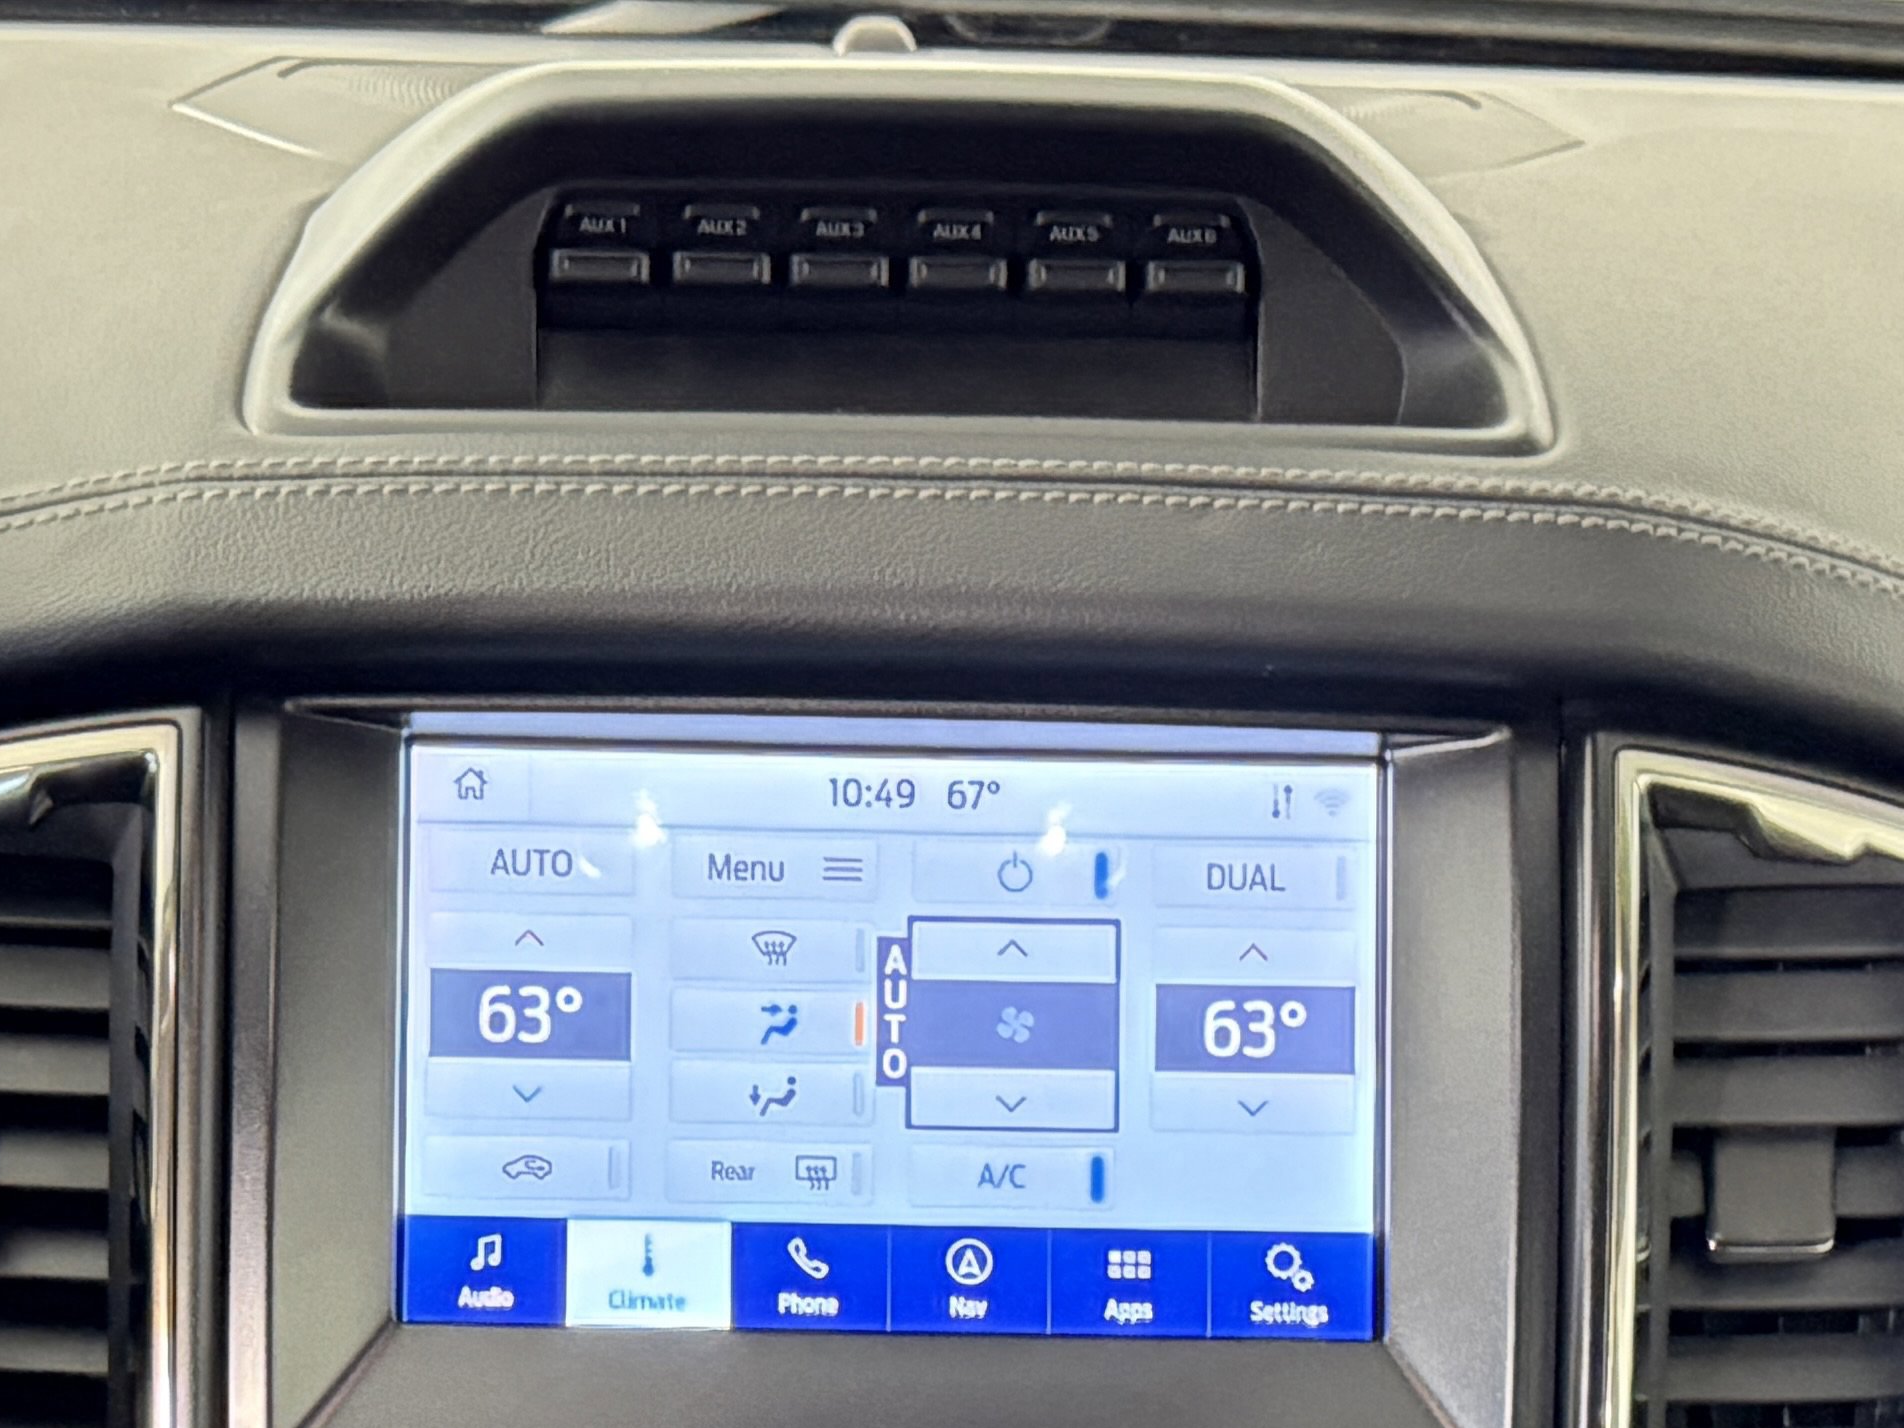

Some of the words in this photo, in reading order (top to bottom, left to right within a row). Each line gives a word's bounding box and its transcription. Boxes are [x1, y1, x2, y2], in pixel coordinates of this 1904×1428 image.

[829, 777, 916, 811] 10:49
[490, 847, 573, 878] AUTO
[707, 853, 785, 883] Menu
[1206, 862, 1287, 893] DUAL
[882, 943, 908, 1079] AUTO
[710, 1159, 756, 1182] Rear
[977, 1161, 1027, 1191] A/C
[457, 1286, 515, 1311] Audio
[608, 1289, 687, 1312] Climate
[777, 1293, 840, 1317] Phone
[948, 1296, 989, 1320] Nav
[1103, 1298, 1154, 1325] Apps
[1249, 1301, 1329, 1328] Settings
